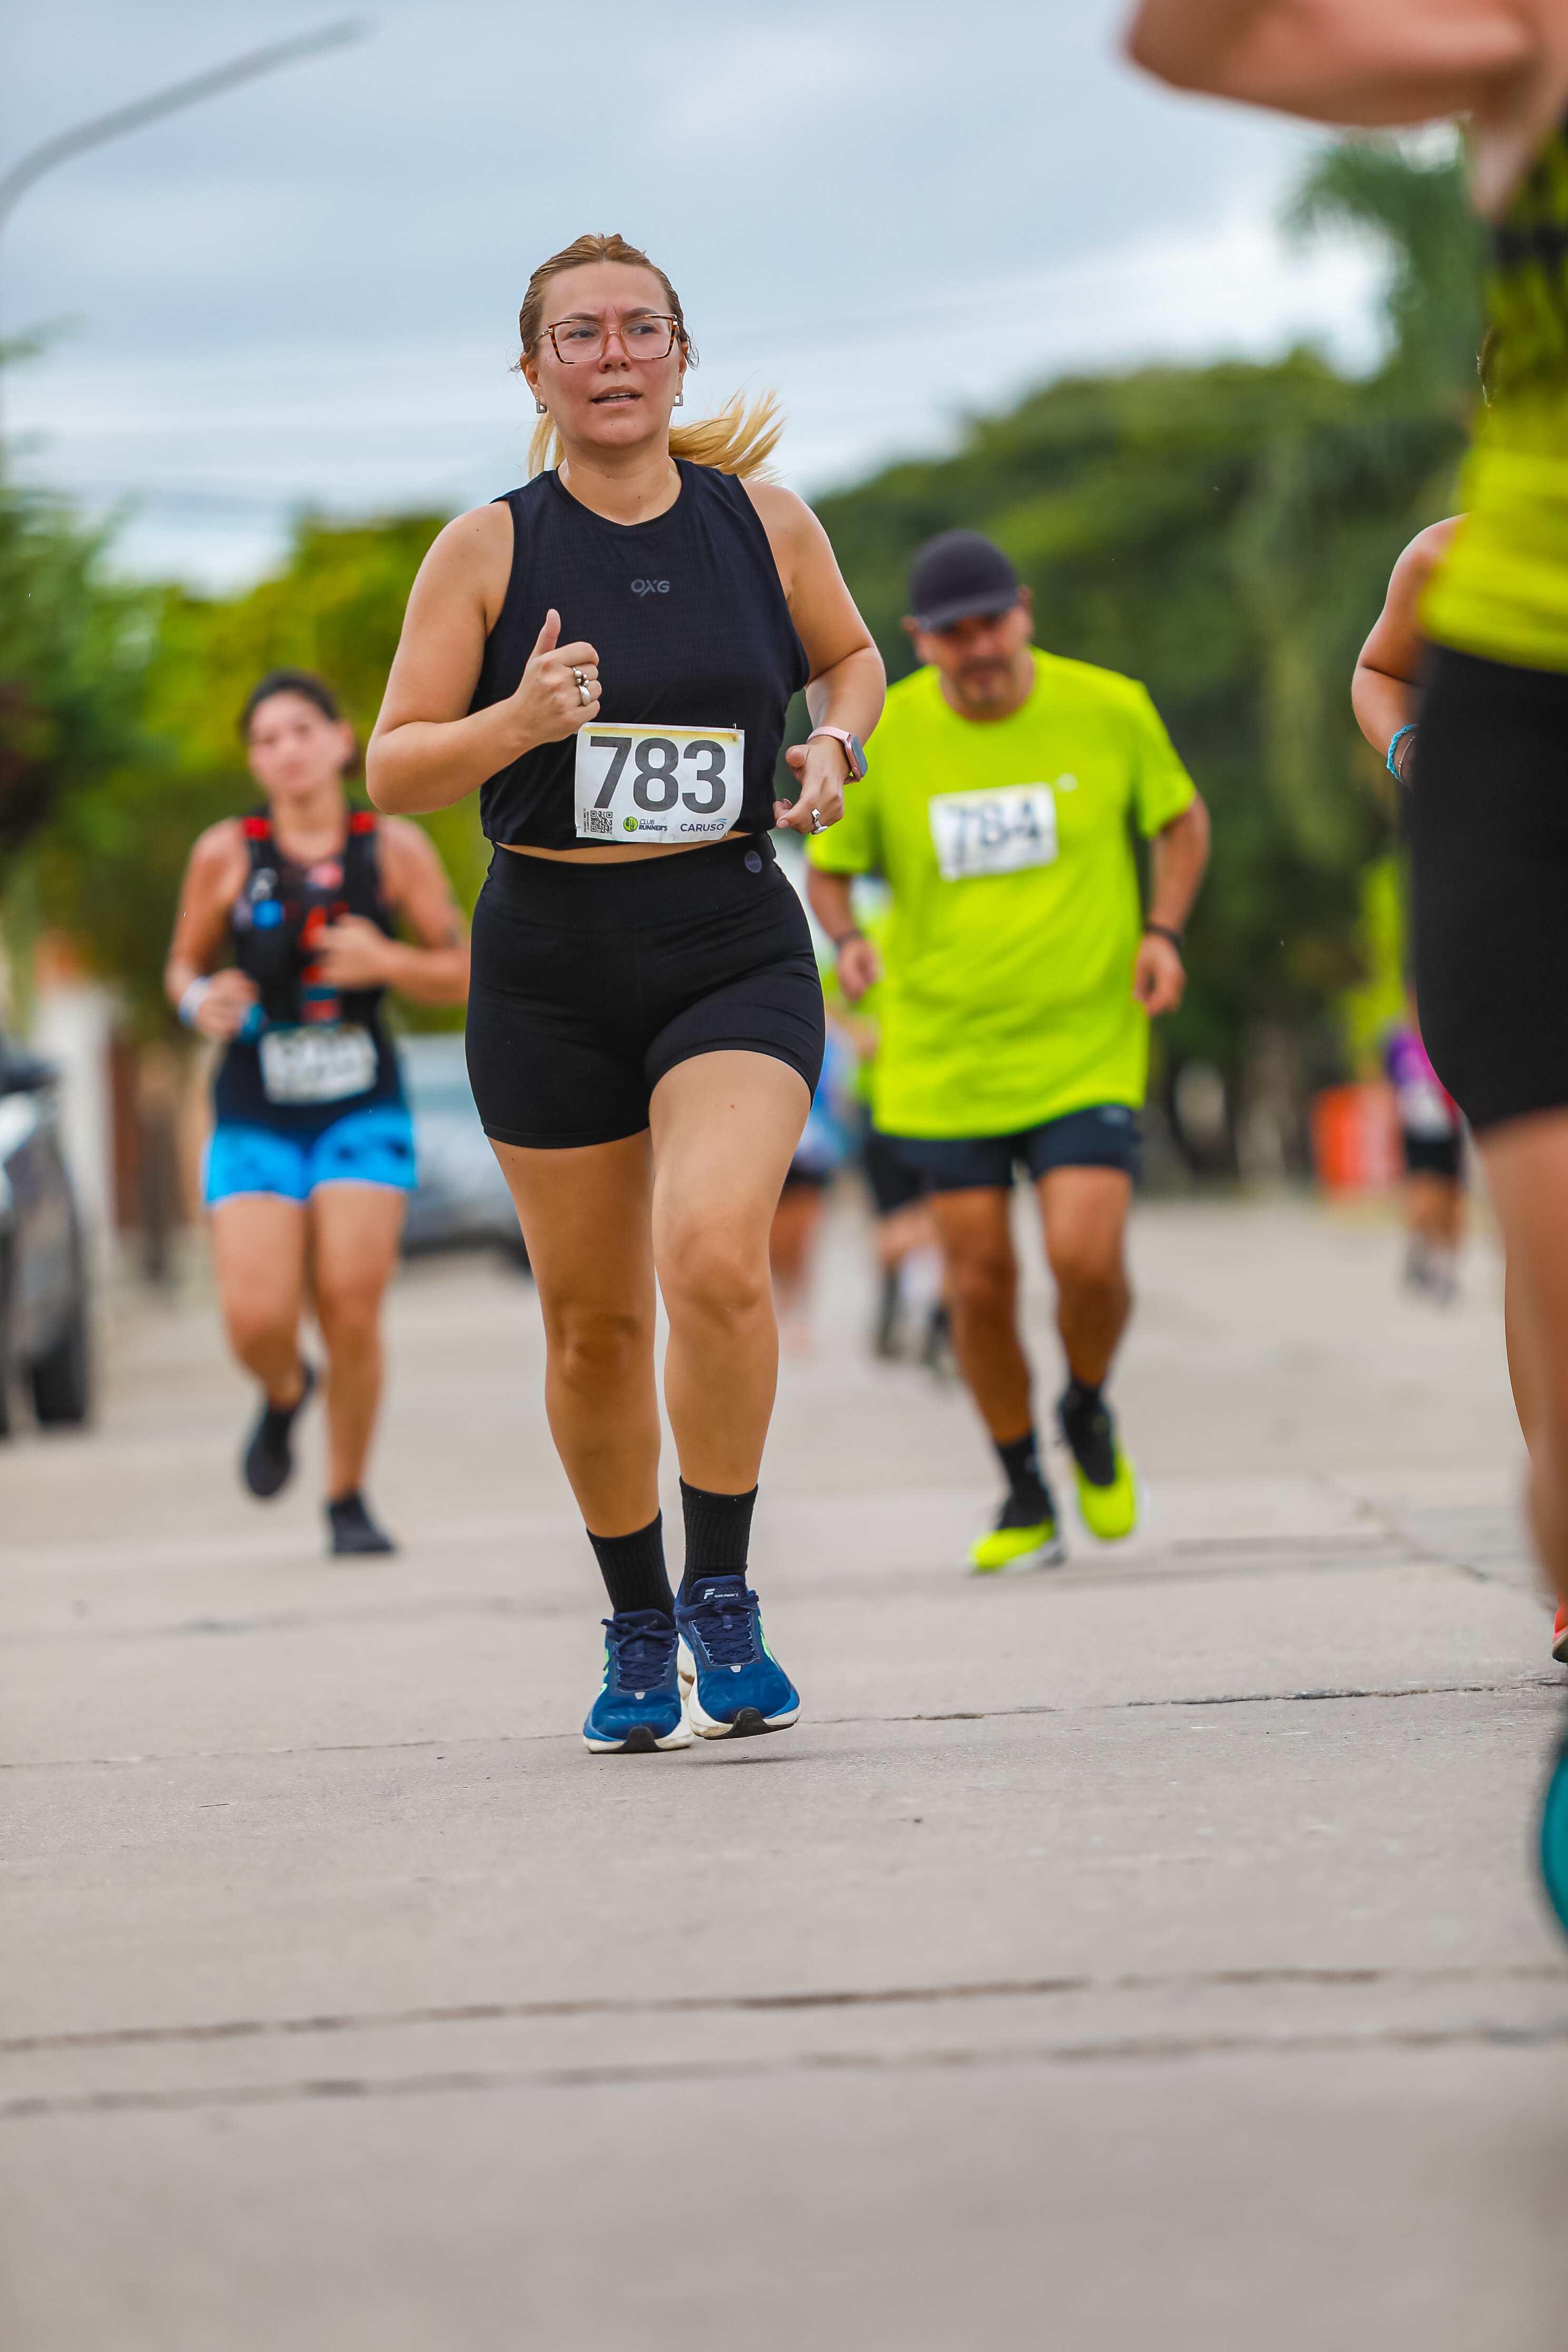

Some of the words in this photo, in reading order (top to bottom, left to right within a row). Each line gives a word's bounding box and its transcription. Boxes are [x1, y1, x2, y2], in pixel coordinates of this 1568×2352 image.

[631, 579, 670, 597] OXG
[590, 736, 726, 814] 783
[680, 824, 724, 832] CARUSO
